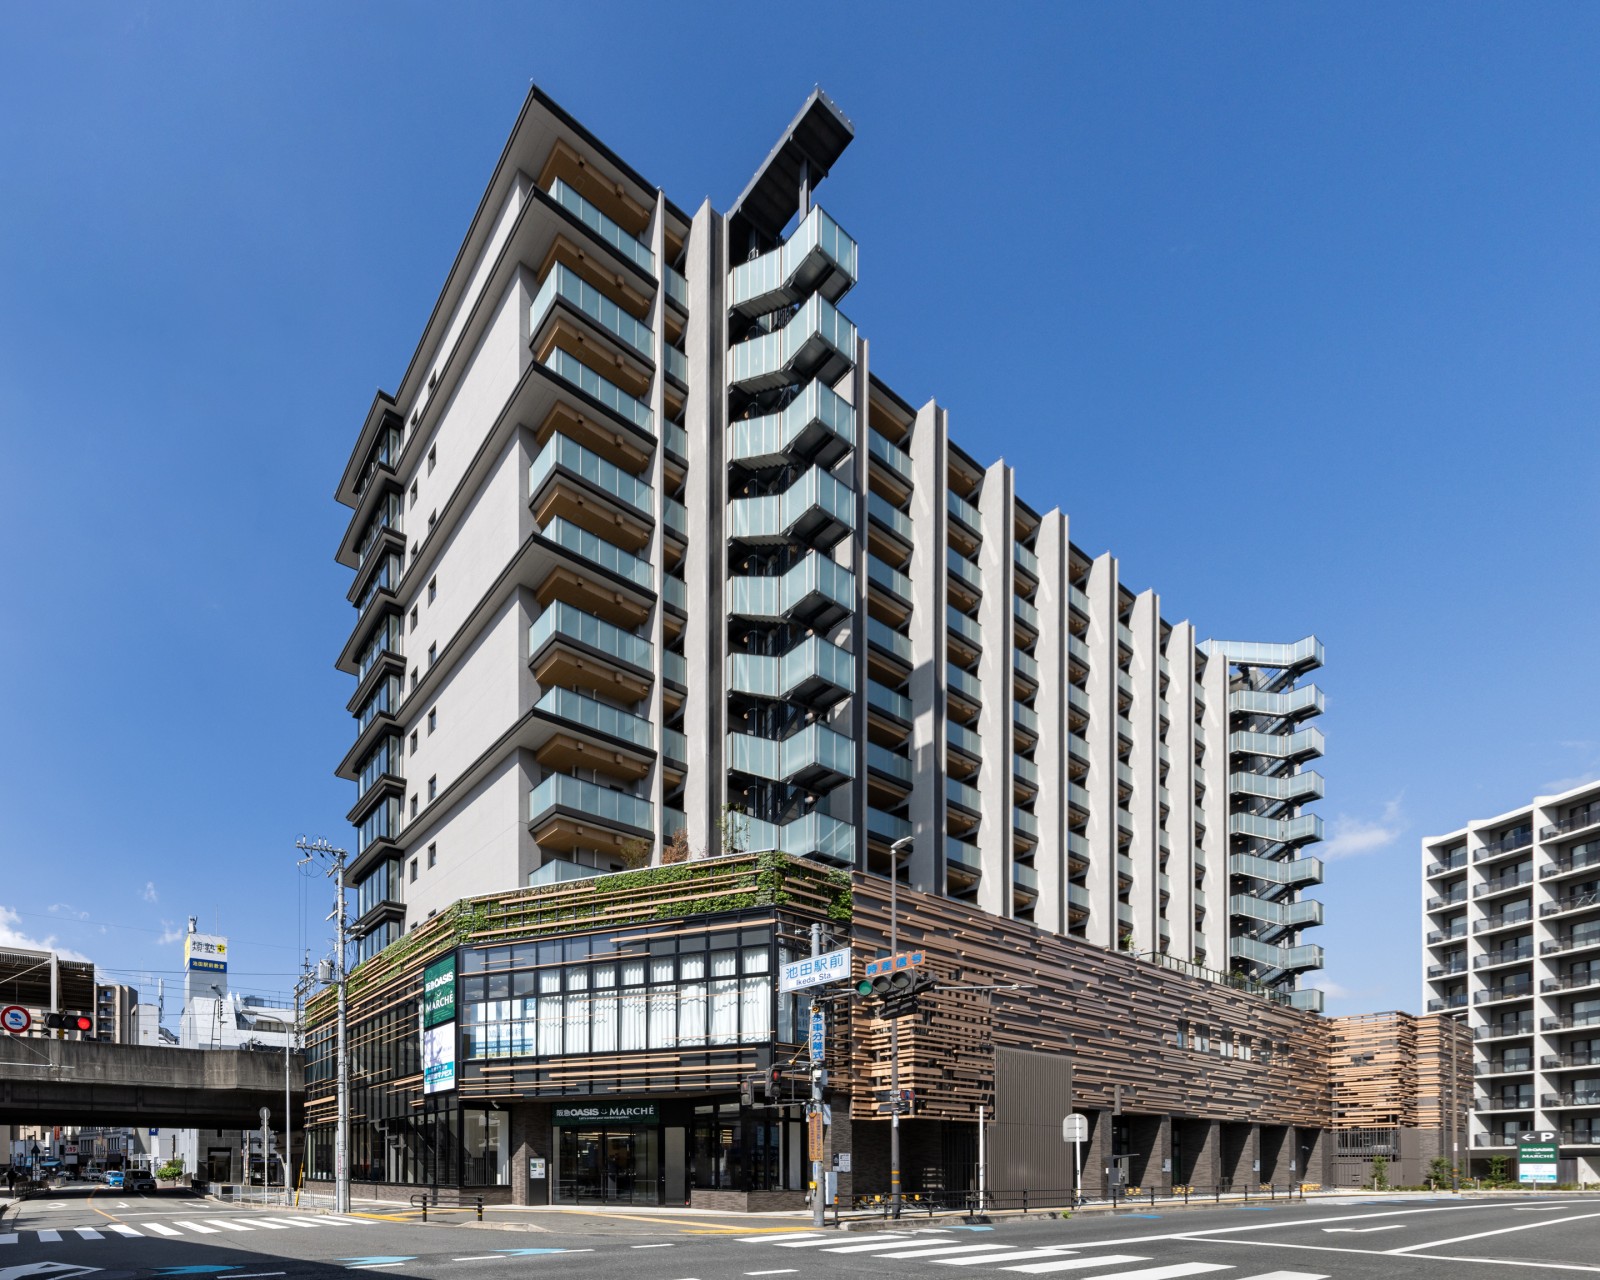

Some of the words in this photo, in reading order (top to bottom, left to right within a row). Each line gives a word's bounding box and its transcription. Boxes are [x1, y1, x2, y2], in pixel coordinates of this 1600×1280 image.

[786, 953, 844, 980] 池田駅前
[796, 977, 816, 986] Ikeda
[425, 990, 454, 1013] MARCHÉ
[812, 1013, 824, 1060] 歩車分離式
[609, 1105, 655, 1116] MARCHÉ
[1541, 1132, 1555, 1142] P
